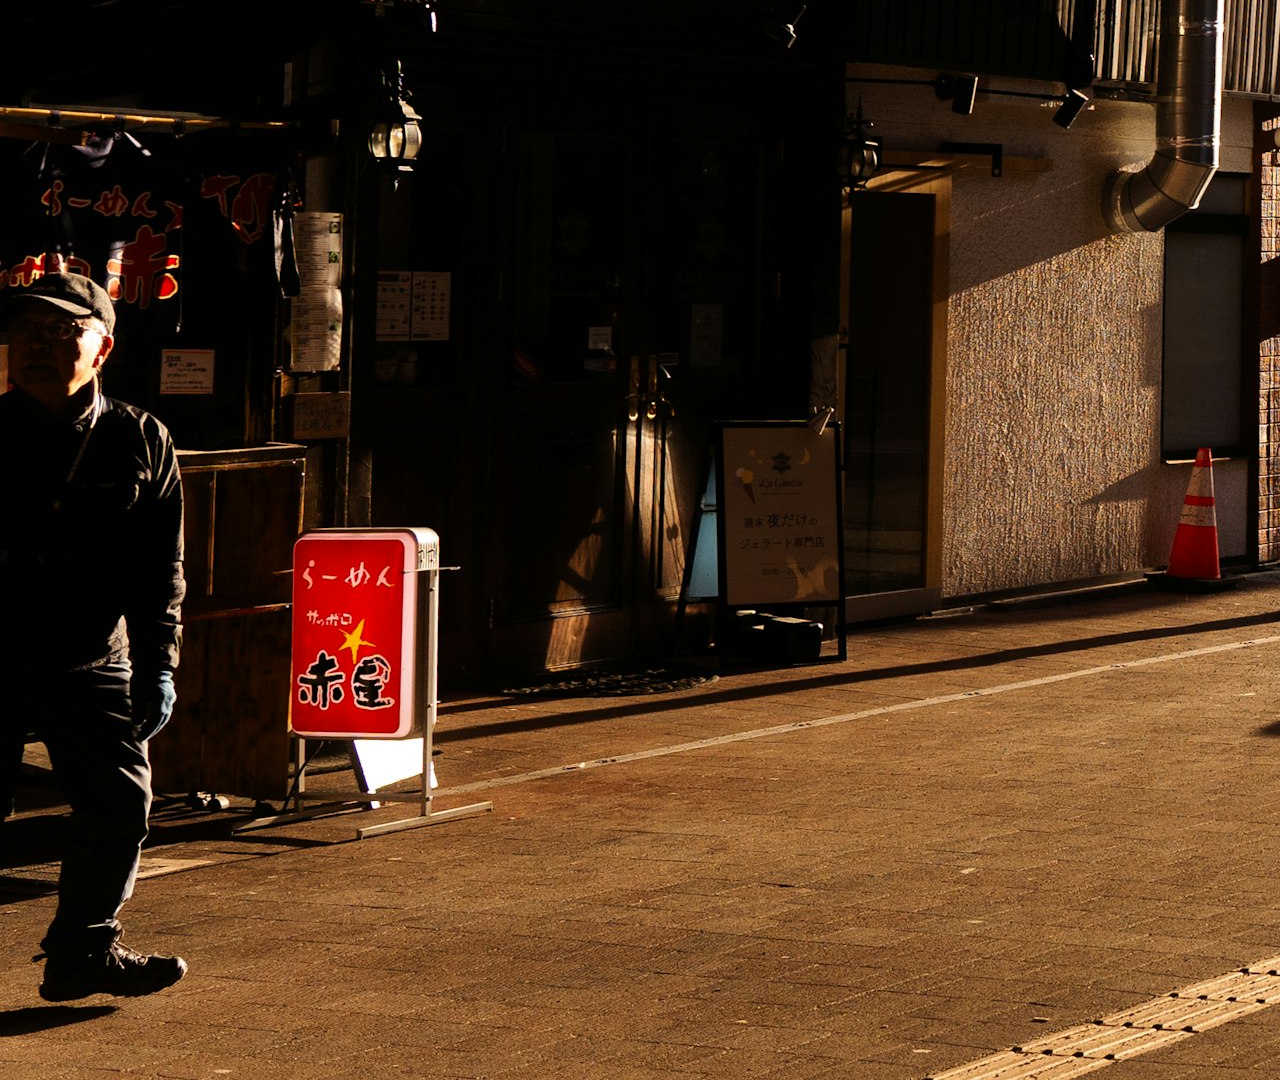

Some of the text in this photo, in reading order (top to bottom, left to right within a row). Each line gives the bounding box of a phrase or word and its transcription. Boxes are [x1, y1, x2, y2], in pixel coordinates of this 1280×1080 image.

[41, 178, 158, 219] らーめん
[739, 536, 825, 550] ジェラート専門店
[302, 559, 396, 590] らーめん
[306, 609, 353, 627] サッポロ
[296, 648, 396, 712] 赤星
